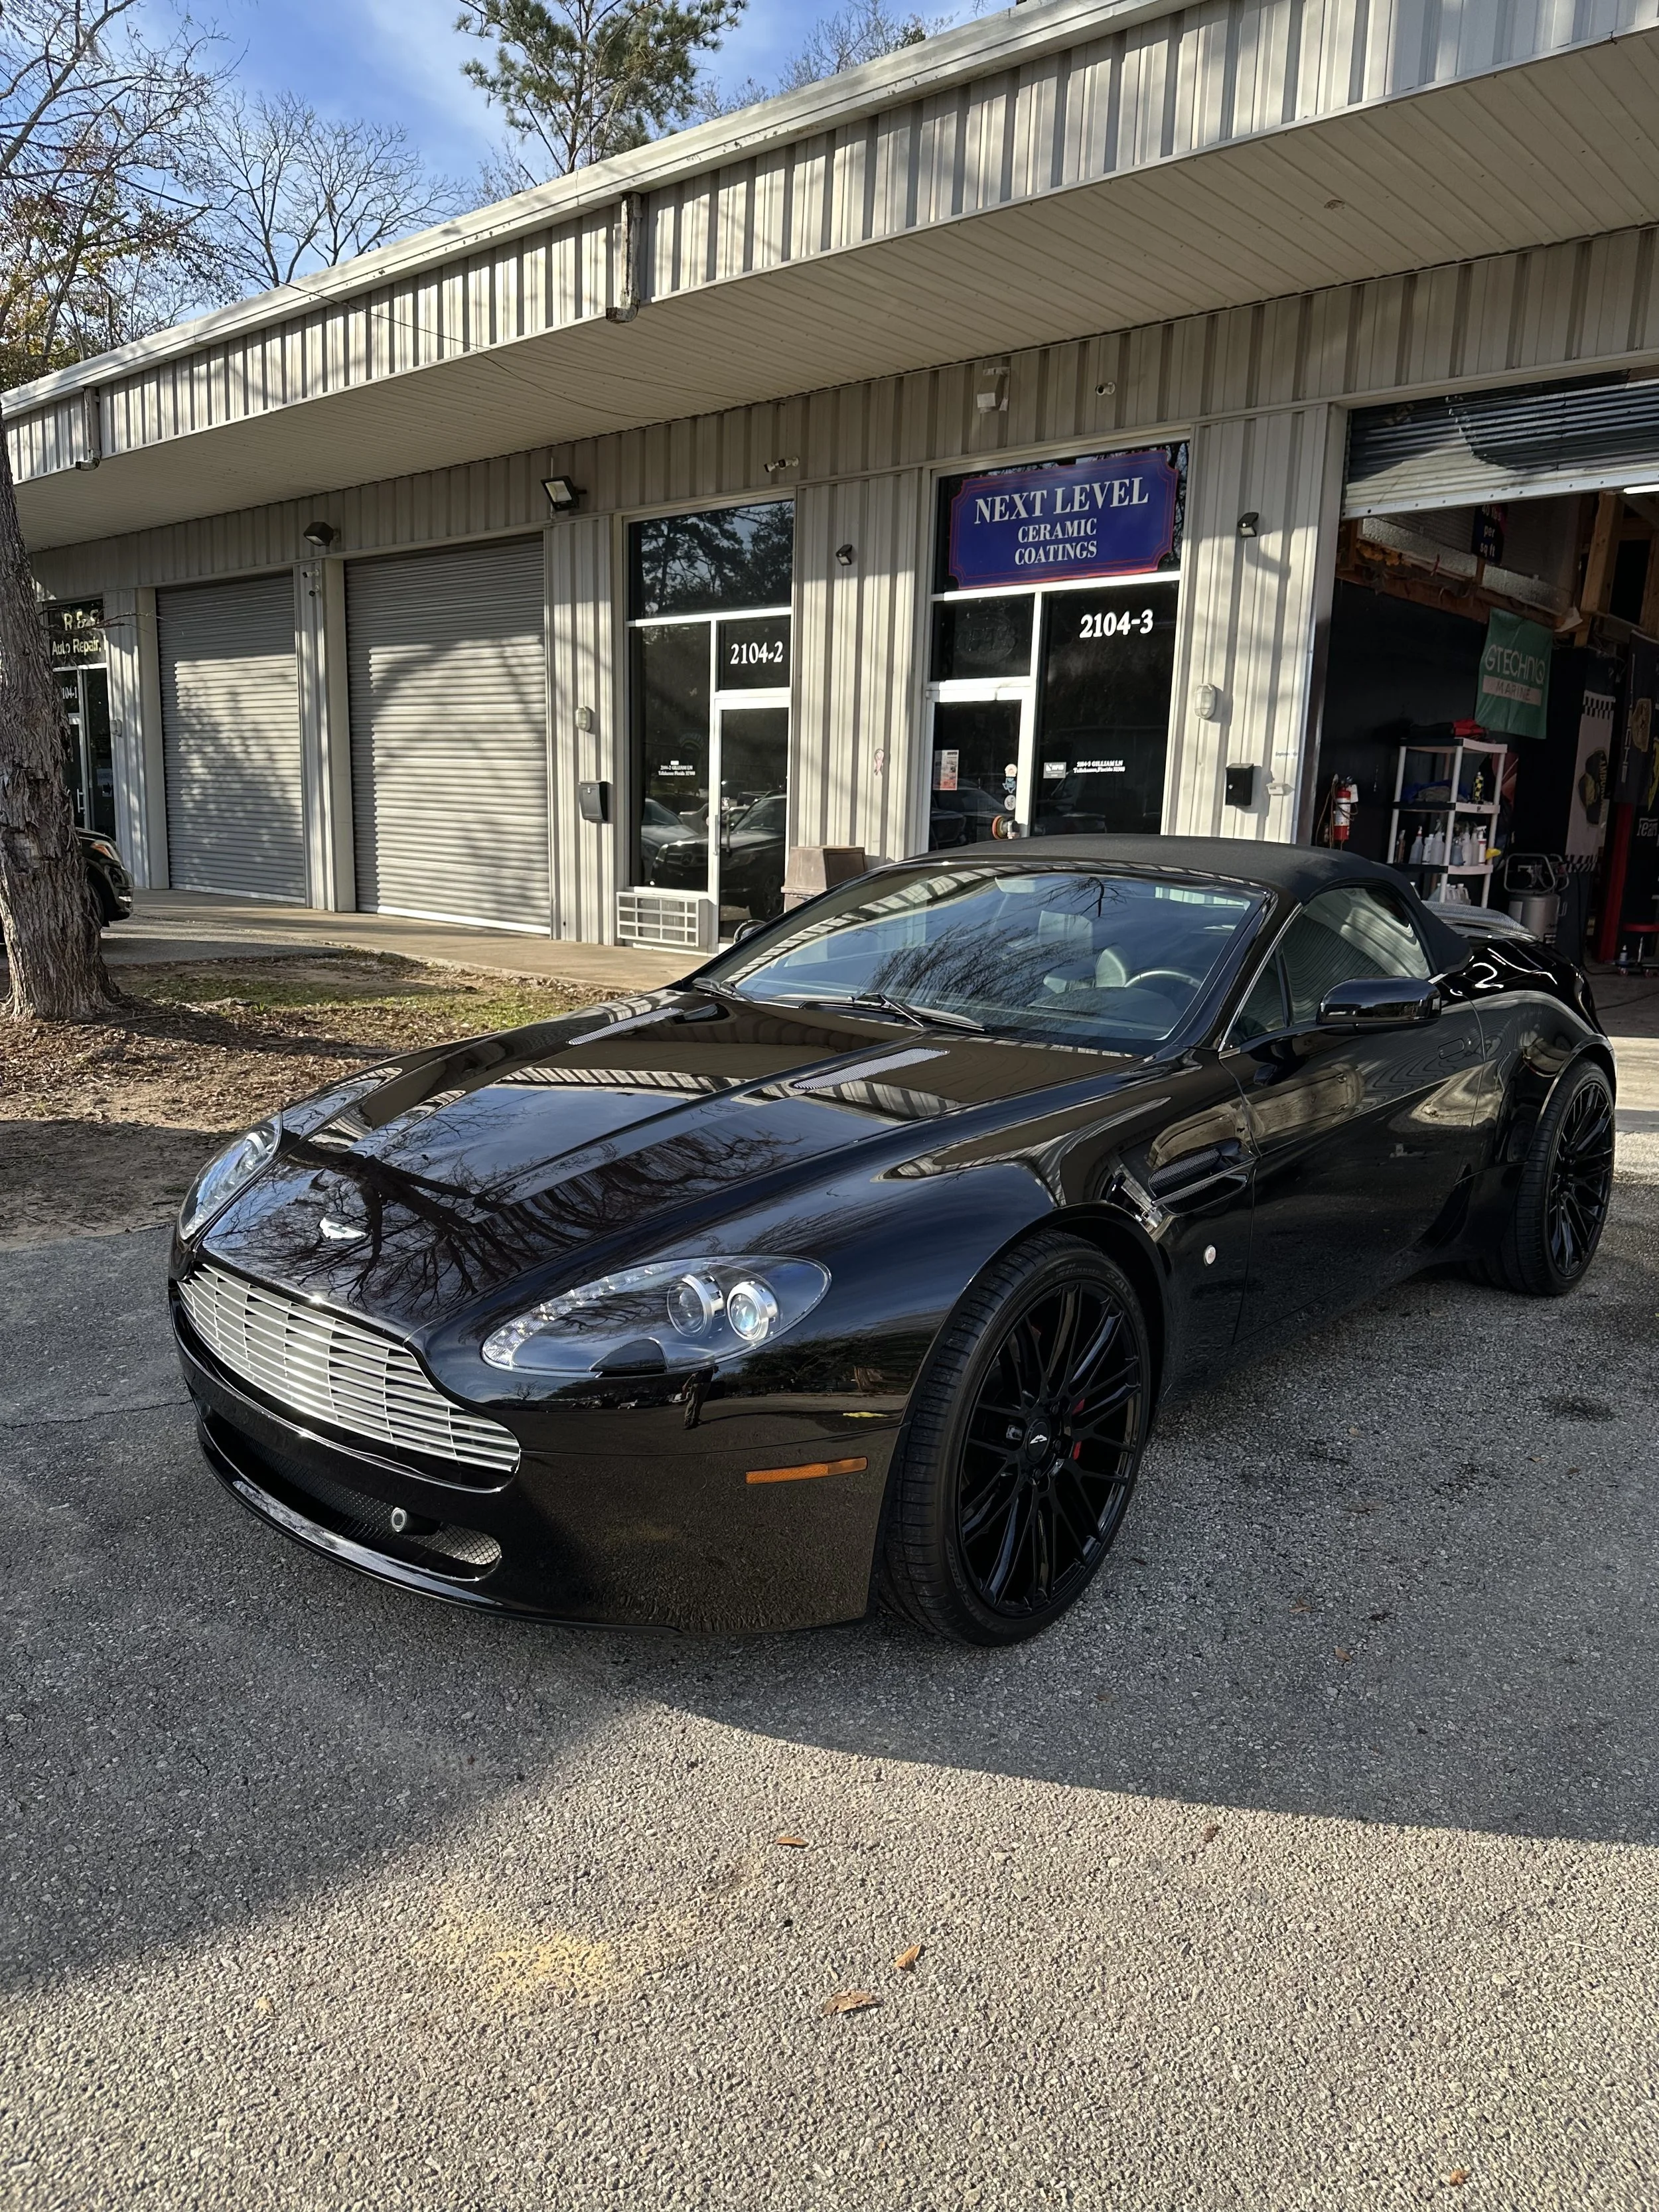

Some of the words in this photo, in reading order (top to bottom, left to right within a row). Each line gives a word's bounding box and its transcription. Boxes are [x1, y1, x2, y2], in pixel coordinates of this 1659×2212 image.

[974, 490, 1046, 524] NEXT
[1053, 477, 1149, 515] LEVEL
[1018, 518, 1097, 543] CERAMIC
[1484, 525, 1496, 538] per
[1015, 540, 1097, 565] COATINGS
[64, 613, 73, 631] R
[1079, 609, 1153, 638] 2104-3
[52, 640, 70, 656] Auto
[729, 640, 784, 664] 2104-2
[1484, 644, 1546, 685] GTECHNIQ
[1497, 680, 1531, 701] MARINE
